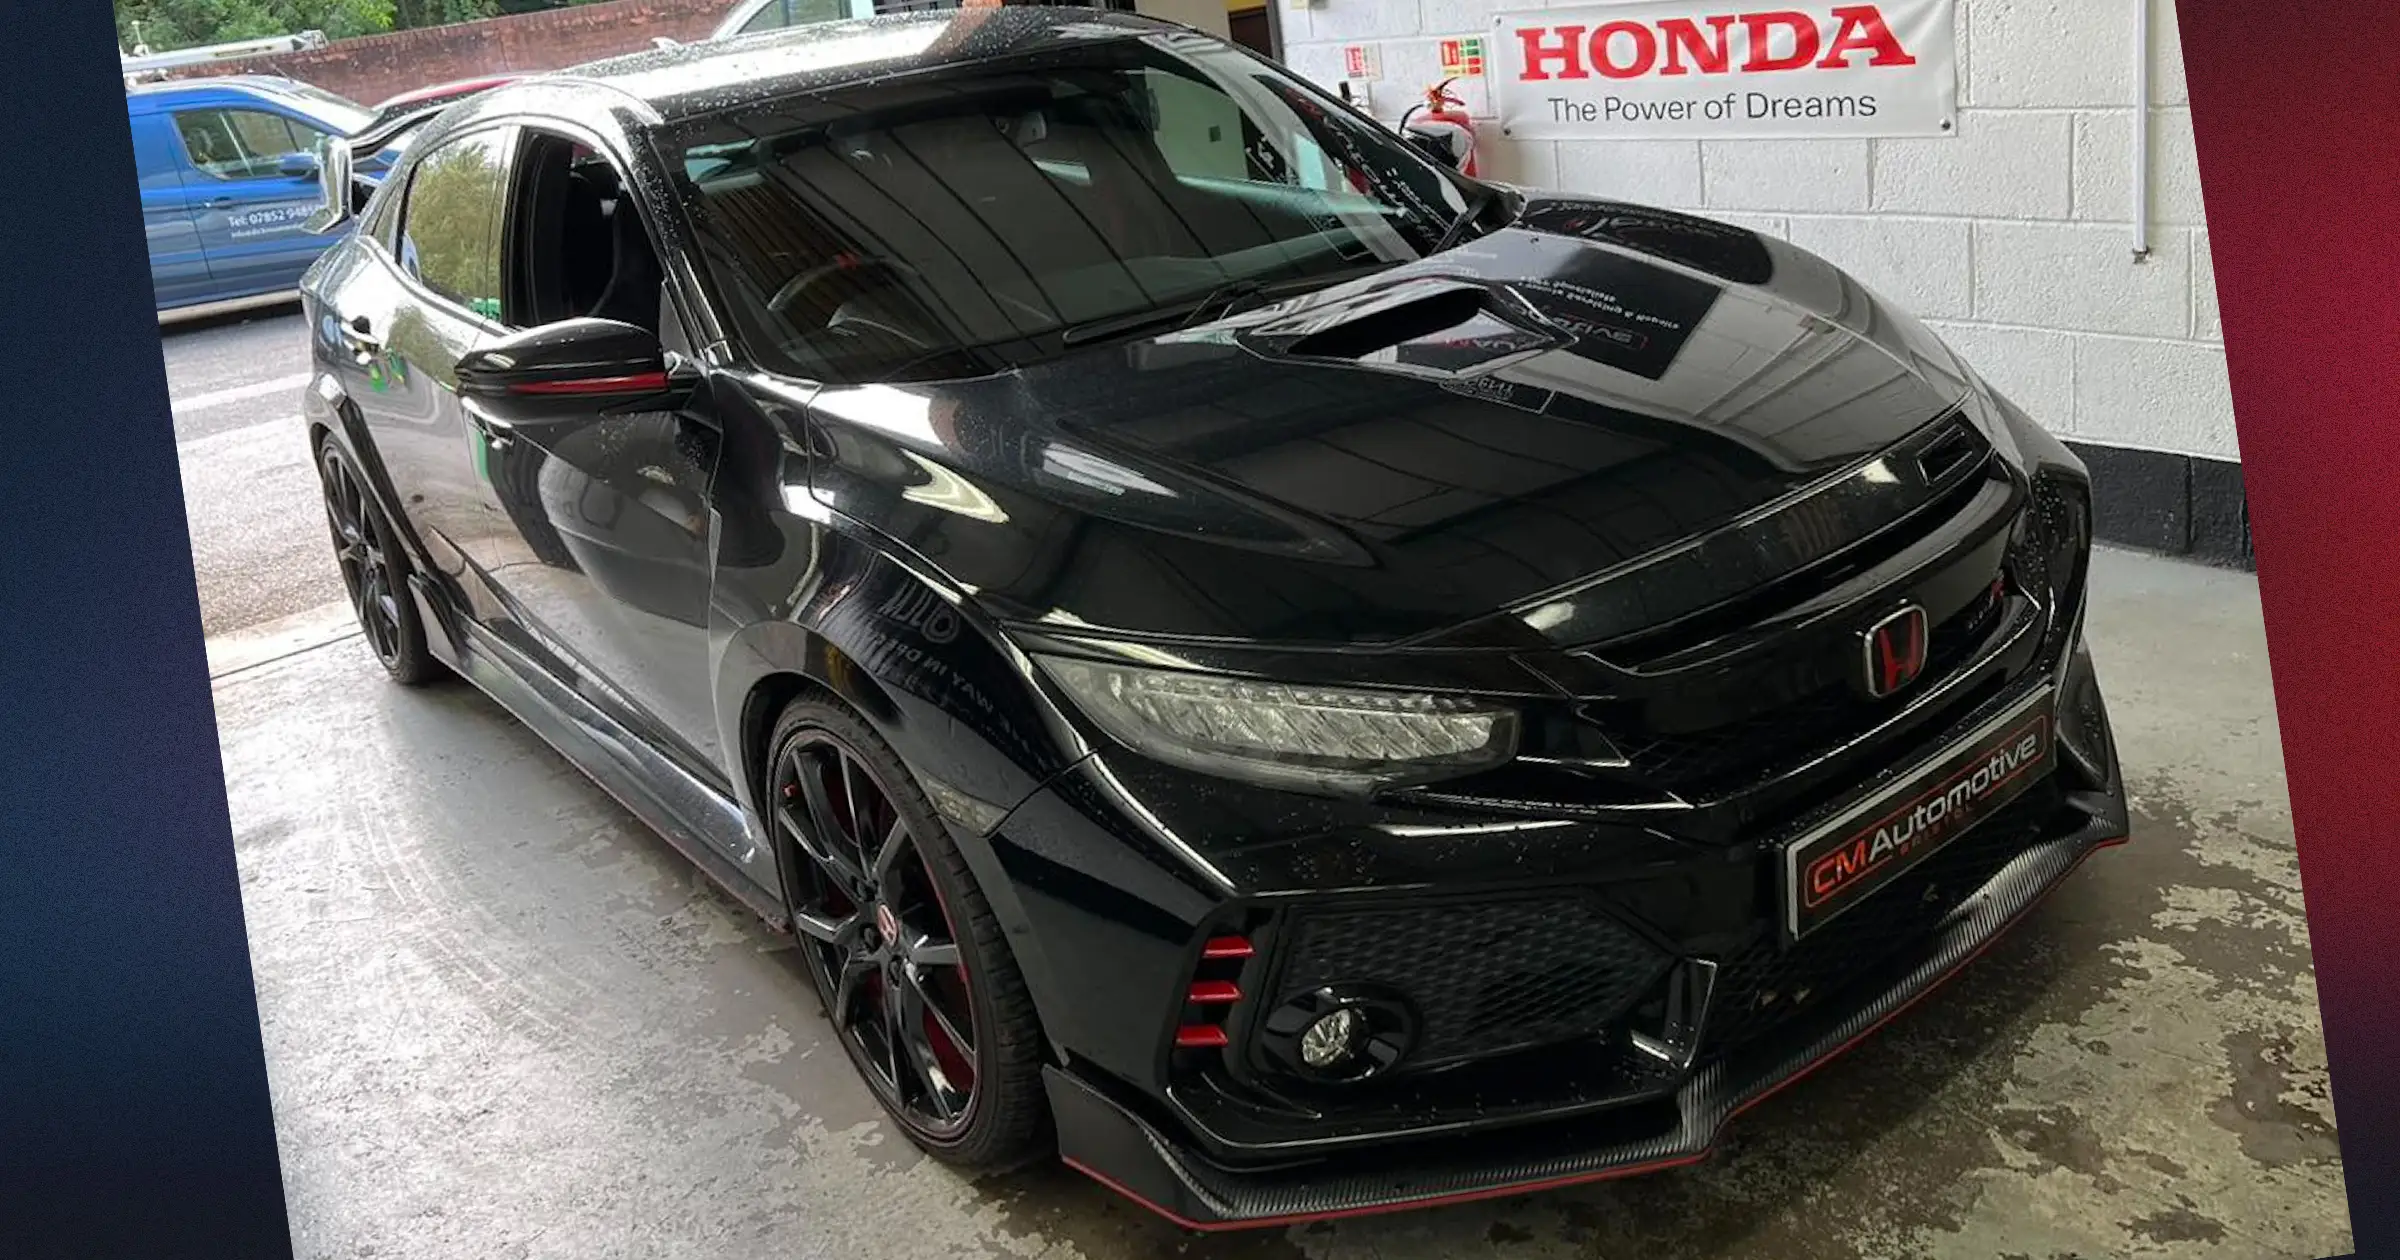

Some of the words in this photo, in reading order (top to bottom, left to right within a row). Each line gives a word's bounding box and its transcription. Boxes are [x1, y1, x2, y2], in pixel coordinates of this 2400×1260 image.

[1516, 4, 1917, 82] HONDA
[1547, 97, 1597, 122] The
[1604, 97, 1697, 120] Power
[1704, 93, 1735, 119] of
[1746, 92, 1876, 118] Dreams
